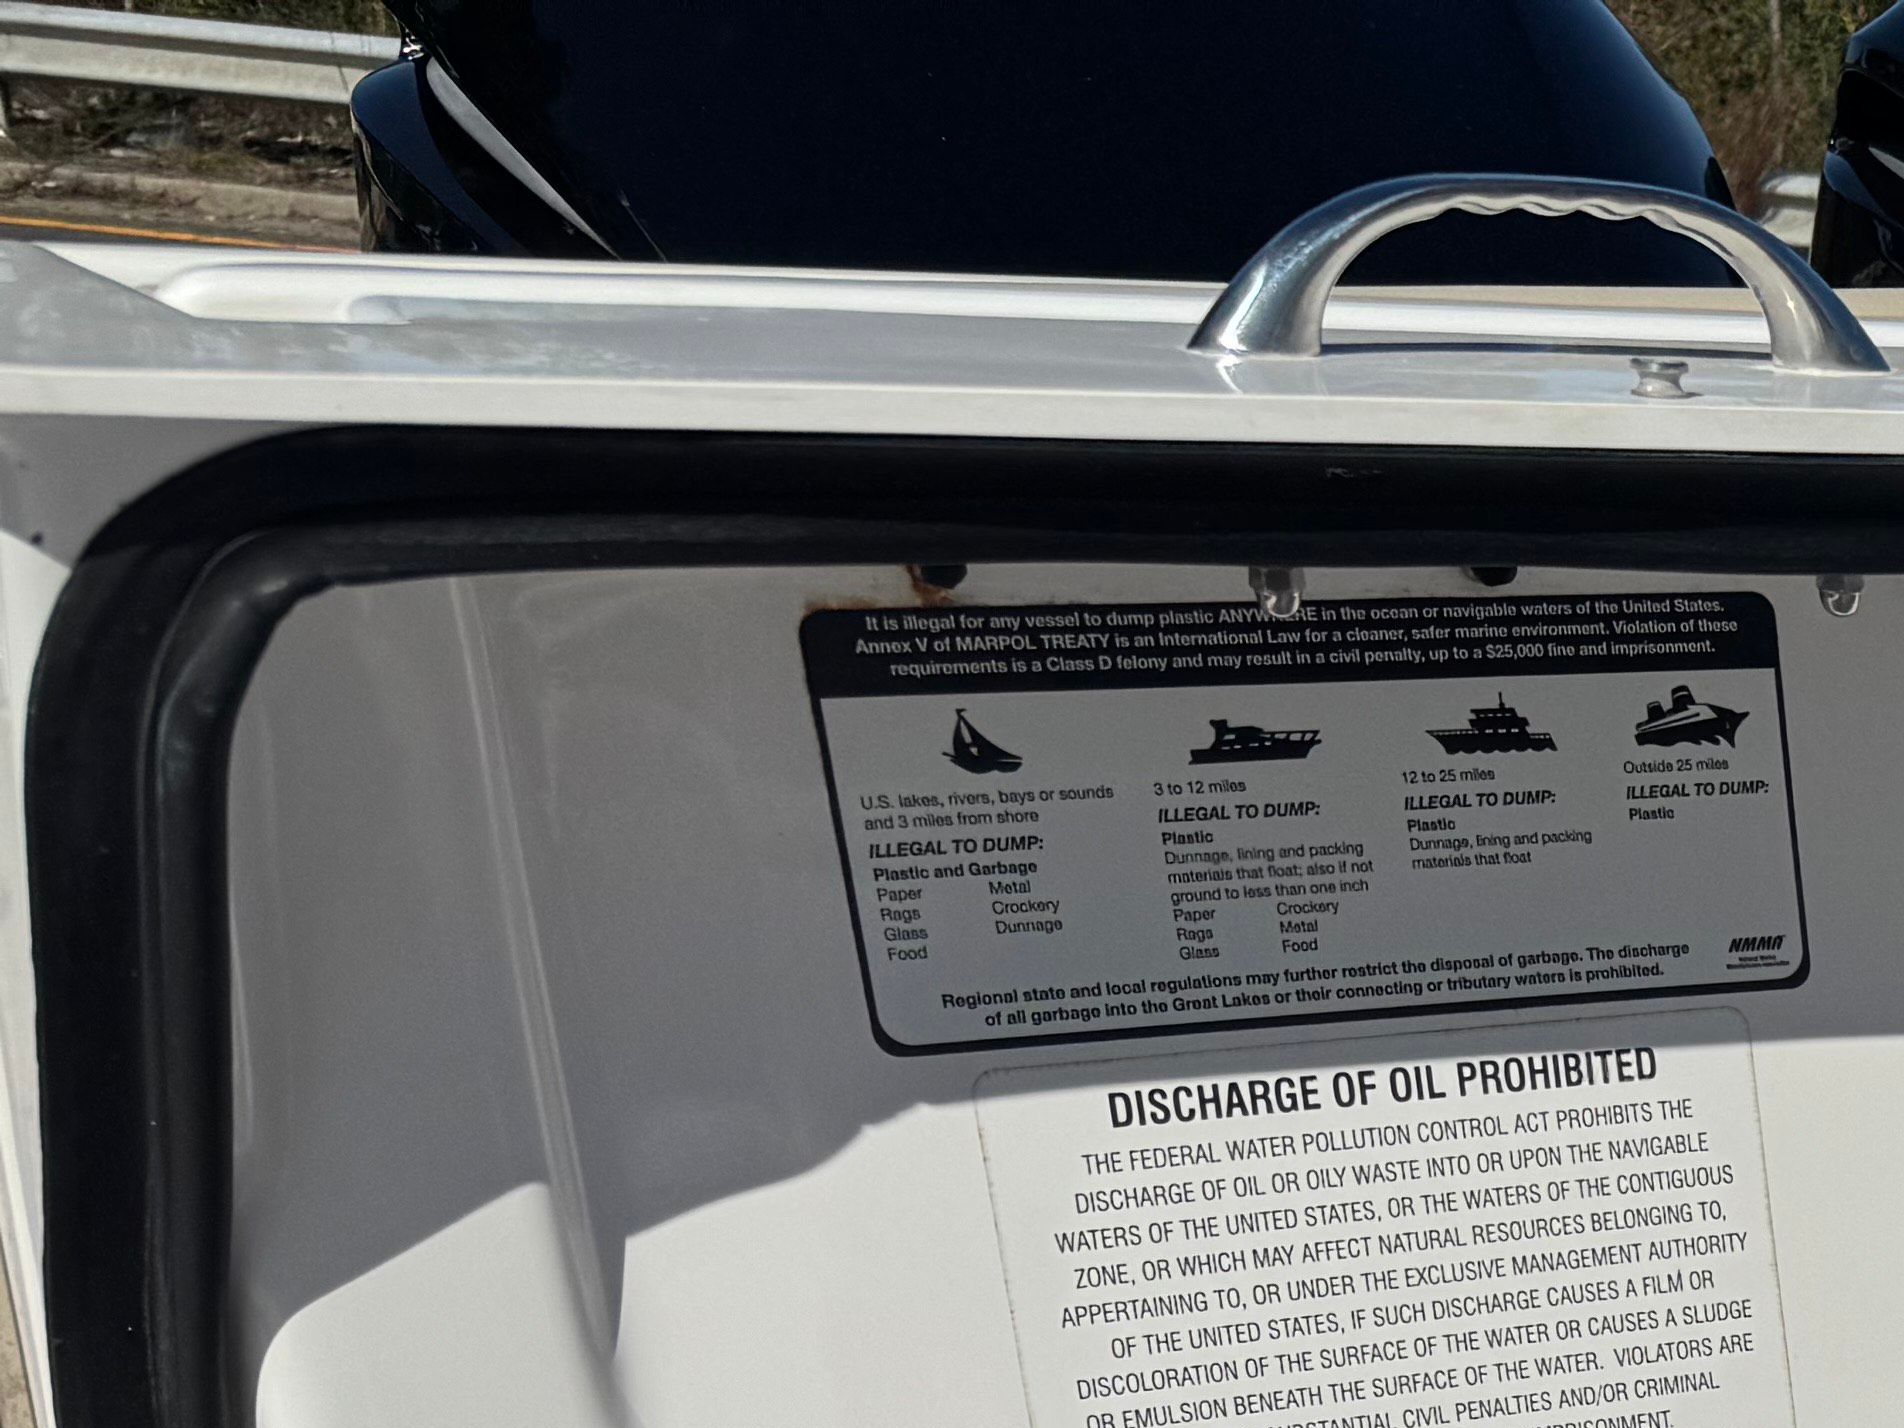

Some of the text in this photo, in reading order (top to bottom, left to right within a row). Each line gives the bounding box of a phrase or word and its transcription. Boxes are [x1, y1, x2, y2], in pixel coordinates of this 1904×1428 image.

[865, 598, 1725, 633] It is illegal for any vessel to dump plastic ANYWRE in the ocean or navigable waters of the United States.
[1402, 767, 1496, 785] 12 to 25 miles
[1623, 757, 1730, 775] Outside 25 miles
[859, 784, 1115, 811] U.S. lakes, rivers, bays or sounds
[1404, 789, 1556, 811] ILLEGAL TO DUMP:
[1626, 779, 1769, 800] ILLEGAL TO DUMP:
[864, 809, 1040, 831] and 3 miles from shore
[1628, 806, 1675, 821] Plastic
[1406, 817, 1456, 833] Plastic
[869, 835, 1044, 859] ILLEGAL TO DUMP:
[872, 861, 1038, 882] Plastic and Garbage
[876, 887, 923, 904] Paper
[988, 879, 1032, 895] Metal
[879, 907, 922, 924] Rags
[991, 899, 1060, 915] Crockery
[883, 926, 929, 942] Glass
[994, 919, 1063, 935] Dunnage
[886, 945, 929, 962] Food
[1107, 1042, 1660, 1128] DISCHARGE OF OIL PROHIBITED
[1081, 1097, 1694, 1175] THE FEDERAL WATER POLLUTION CONTROL ACT PROHIBITS THE
[1074, 1131, 1709, 1214] DISCHARGE OF OIL OR OILY WASTE INTO OR UPON THE NAVIGABLE
[1054, 1164, 1734, 1254] WATERS OF THE UNITED STATES, OR THE WATERS OF THE CONTIGUOUS
[1073, 1199, 1727, 1289] ZONE, OR WHICH MAY AFFECT NATURAL RESOURCES BELONGING TO,
[1061, 1231, 1747, 1329] APPERTAINING TO, OR UNDER THE EXCLUSIVE MANAGEMENT AUTHORITY
[1402, 1405, 1451, 1428] CIVIL
[1455, 1391, 1553, 1423] PENALTIES
[1558, 1382, 1629, 1409] AND/OR
[1634, 1371, 1721, 1399] CRIMINAL
